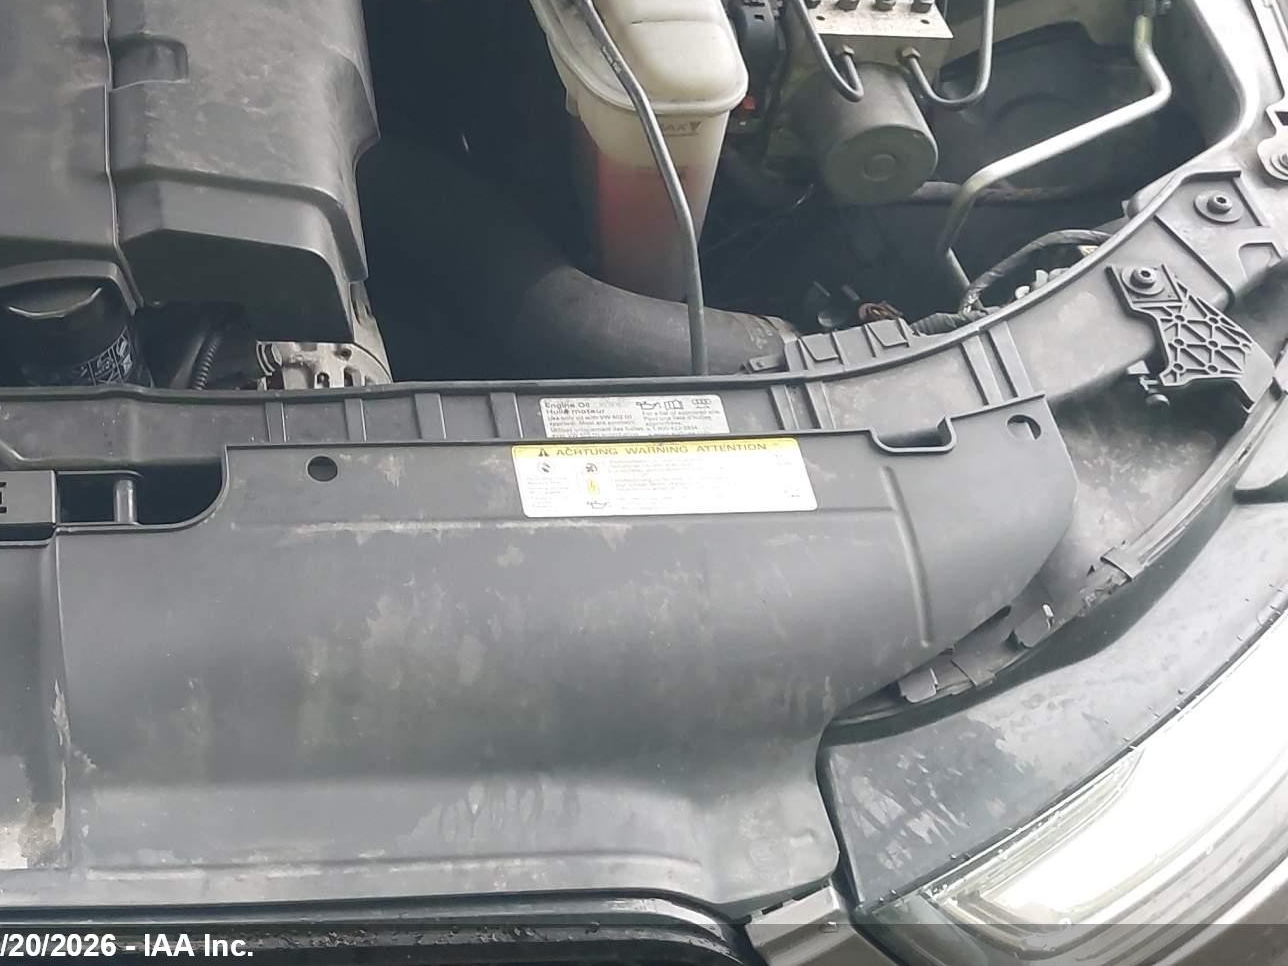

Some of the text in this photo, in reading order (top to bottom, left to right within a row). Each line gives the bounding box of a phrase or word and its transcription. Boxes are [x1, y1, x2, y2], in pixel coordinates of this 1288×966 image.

[545, 401, 575, 410] Engine
[556, 442, 767, 457] ACHTUNG WARNING ATTENTION
